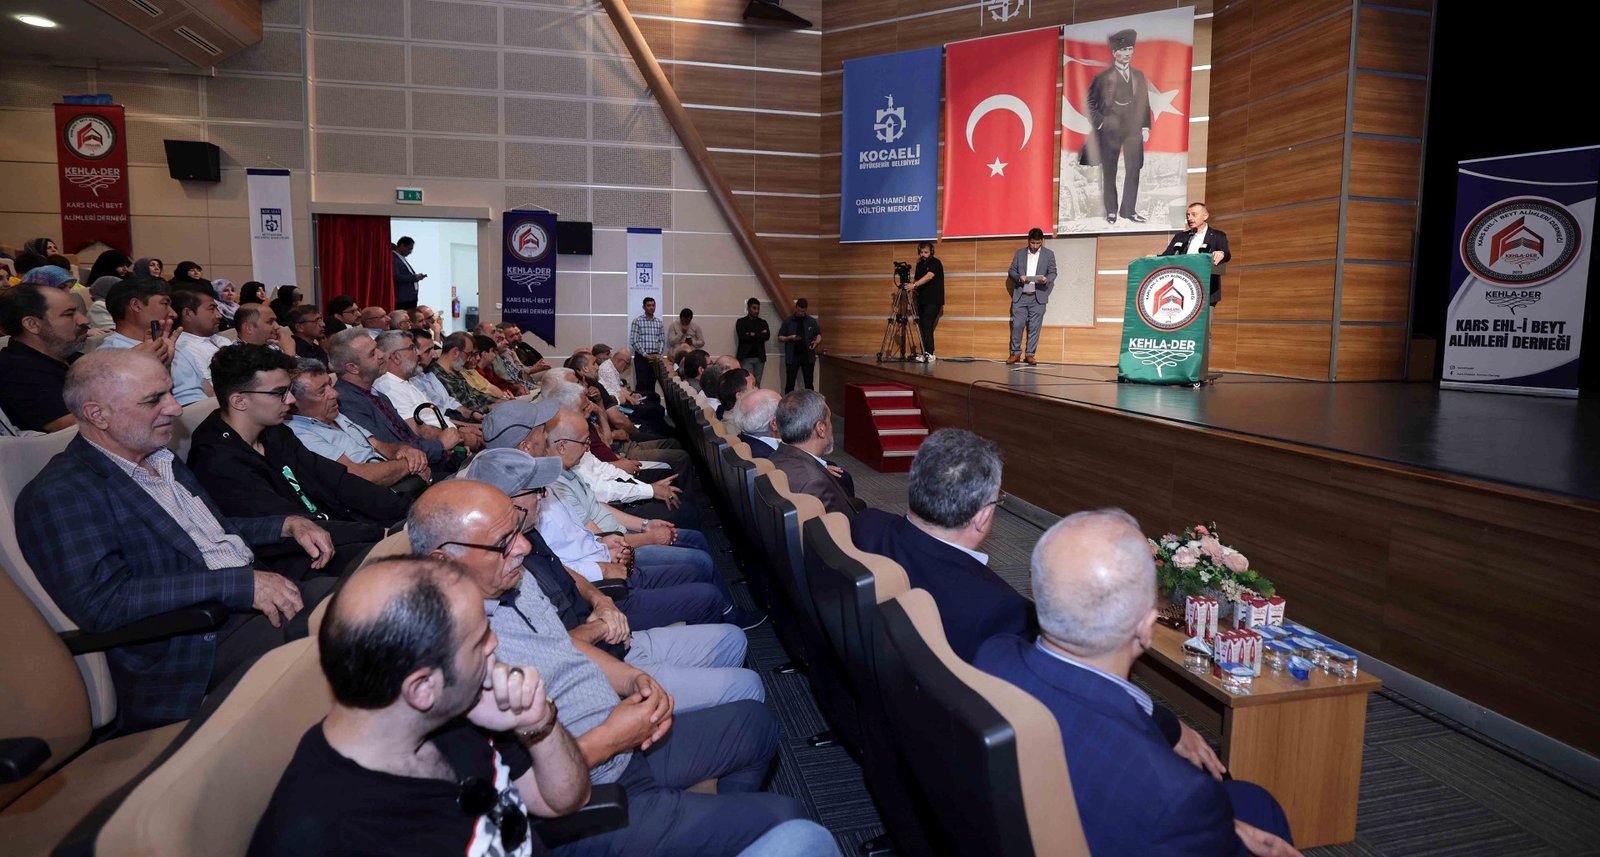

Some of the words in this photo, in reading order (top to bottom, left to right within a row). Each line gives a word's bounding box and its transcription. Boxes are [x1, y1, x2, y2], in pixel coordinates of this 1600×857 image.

[860, 144, 920, 162] KOCAELİ
[892, 158, 920, 167] BELEDİYESİ
[64, 167, 120, 175] KEHLA-DER
[882, 196, 906, 204] HAMDİ
[858, 206, 886, 214] KÜLTÜR
[888, 204, 920, 212] MERKEZİ
[1500, 210, 1518, 220] BEYT
[1519, 210, 1551, 222] ALİMLERİ
[506, 266, 551, 274] KEHLA-DER
[1456, 320, 1489, 332] KARS
[1493, 318, 1528, 332] EHL-İ
[1531, 320, 1566, 334] BEYT
[1129, 338, 1196, 350] KEHLA-DER
[1449, 333, 1508, 348] ALİMLERİ
[1512, 335, 1570, 351] DERNEĞİ
